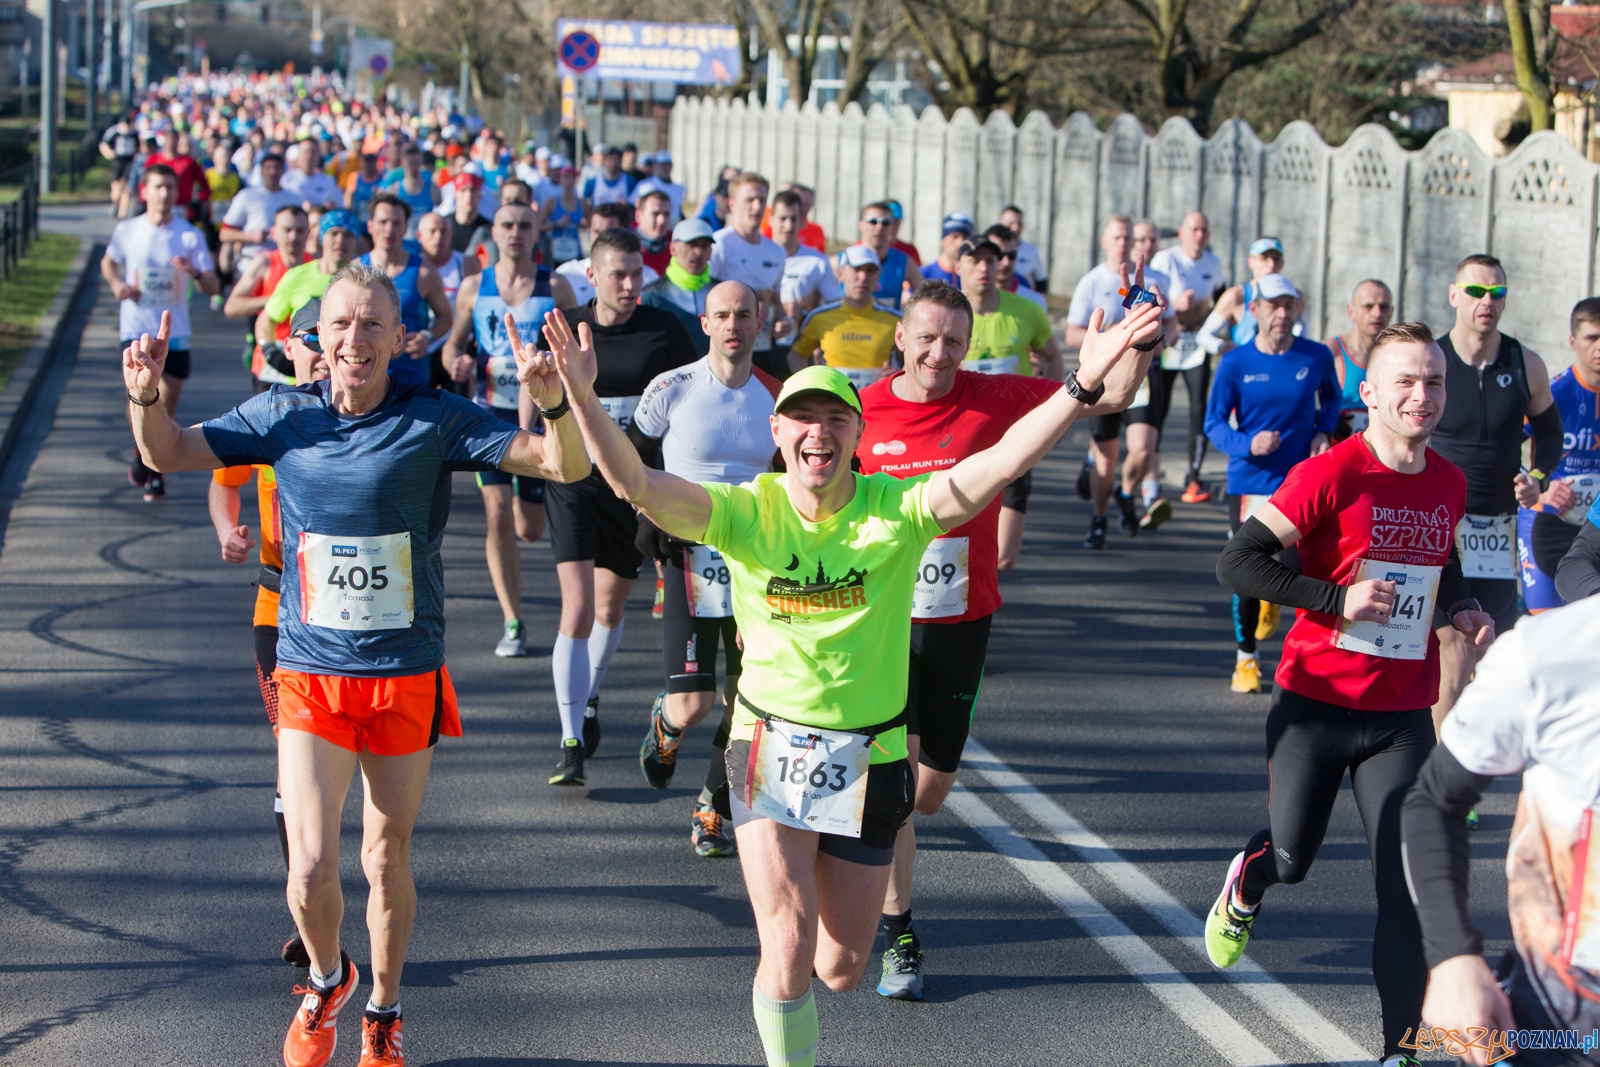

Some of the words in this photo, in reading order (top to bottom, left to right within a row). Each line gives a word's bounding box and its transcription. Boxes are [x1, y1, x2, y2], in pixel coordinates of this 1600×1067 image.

[599, 46, 701, 69] IMOWEGO
[881, 464, 911, 472] FEHLAU
[912, 460, 932, 469] RUN
[933, 458, 956, 466] TEAM
[1372, 506, 1439, 527] DRUŻYNA
[1369, 524, 1450, 552] SZPIKU
[1460, 533, 1510, 551] 10102
[327, 565, 389, 591] 405
[343, 593, 375, 602] Tomasz
[766, 587, 867, 615] FINISHER
[1390, 594, 1425, 619] 141
[777, 756, 847, 792] 1863
